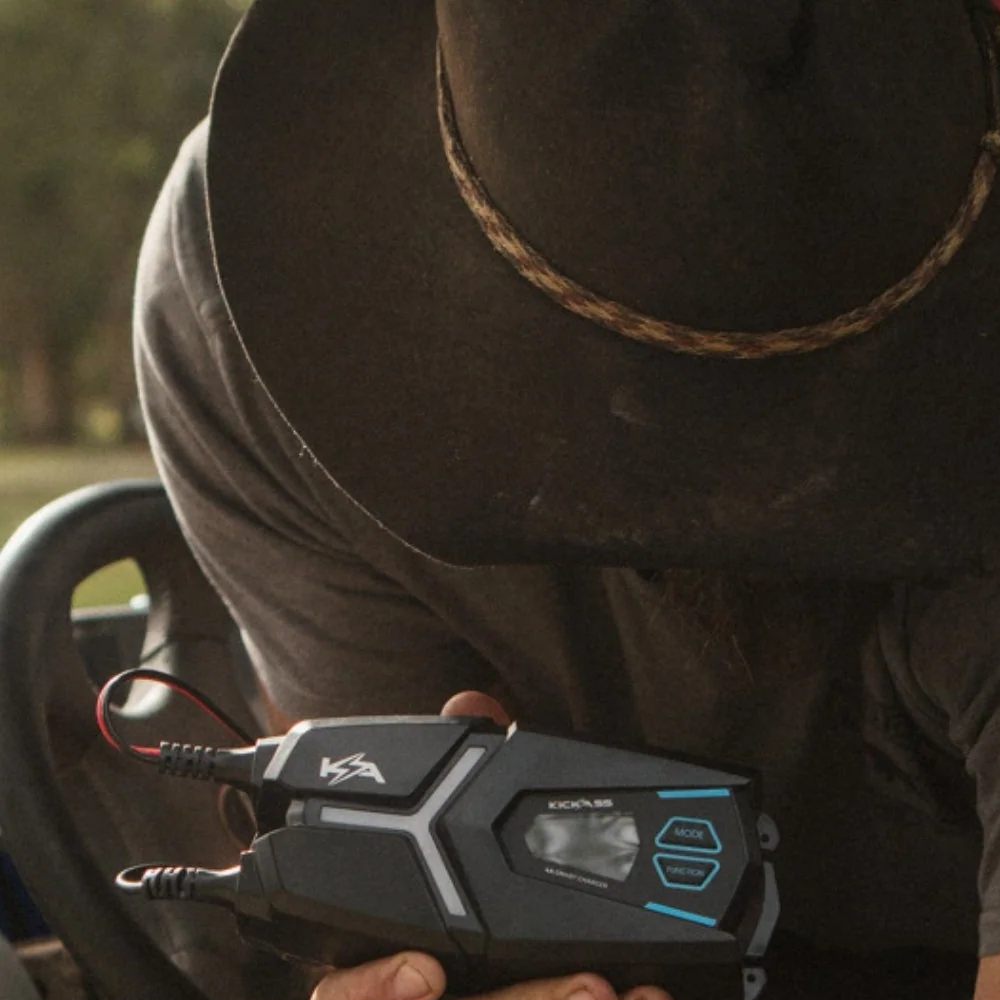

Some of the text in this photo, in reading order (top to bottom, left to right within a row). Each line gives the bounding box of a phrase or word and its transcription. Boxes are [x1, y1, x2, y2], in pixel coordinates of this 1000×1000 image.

[547, 798, 614, 811] KICKASS
[674, 827, 705, 841] MODE
[666, 865, 706, 877] FUNCTION
